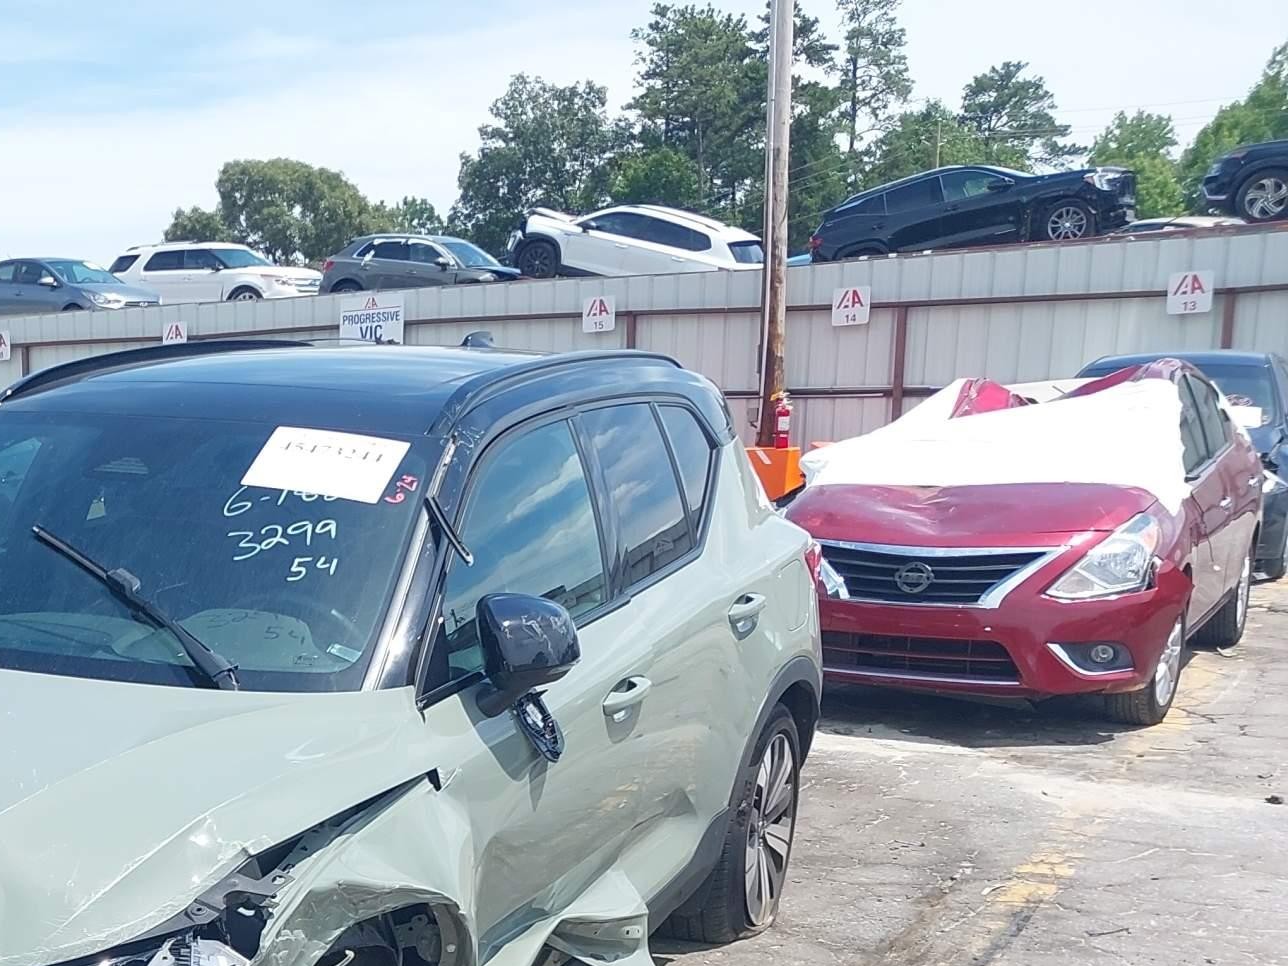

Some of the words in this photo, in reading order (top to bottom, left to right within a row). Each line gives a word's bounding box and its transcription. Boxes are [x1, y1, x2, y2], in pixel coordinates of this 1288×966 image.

[1182, 301, 1198, 311] 13
[342, 310, 401, 326] PROGRESSIVE
[594, 321, 604, 330] 15
[844, 313, 857, 323] 14
[359, 324, 383, 341] VIC
[227, 519, 337, 561] 3299
[286, 556, 338, 581] 54
